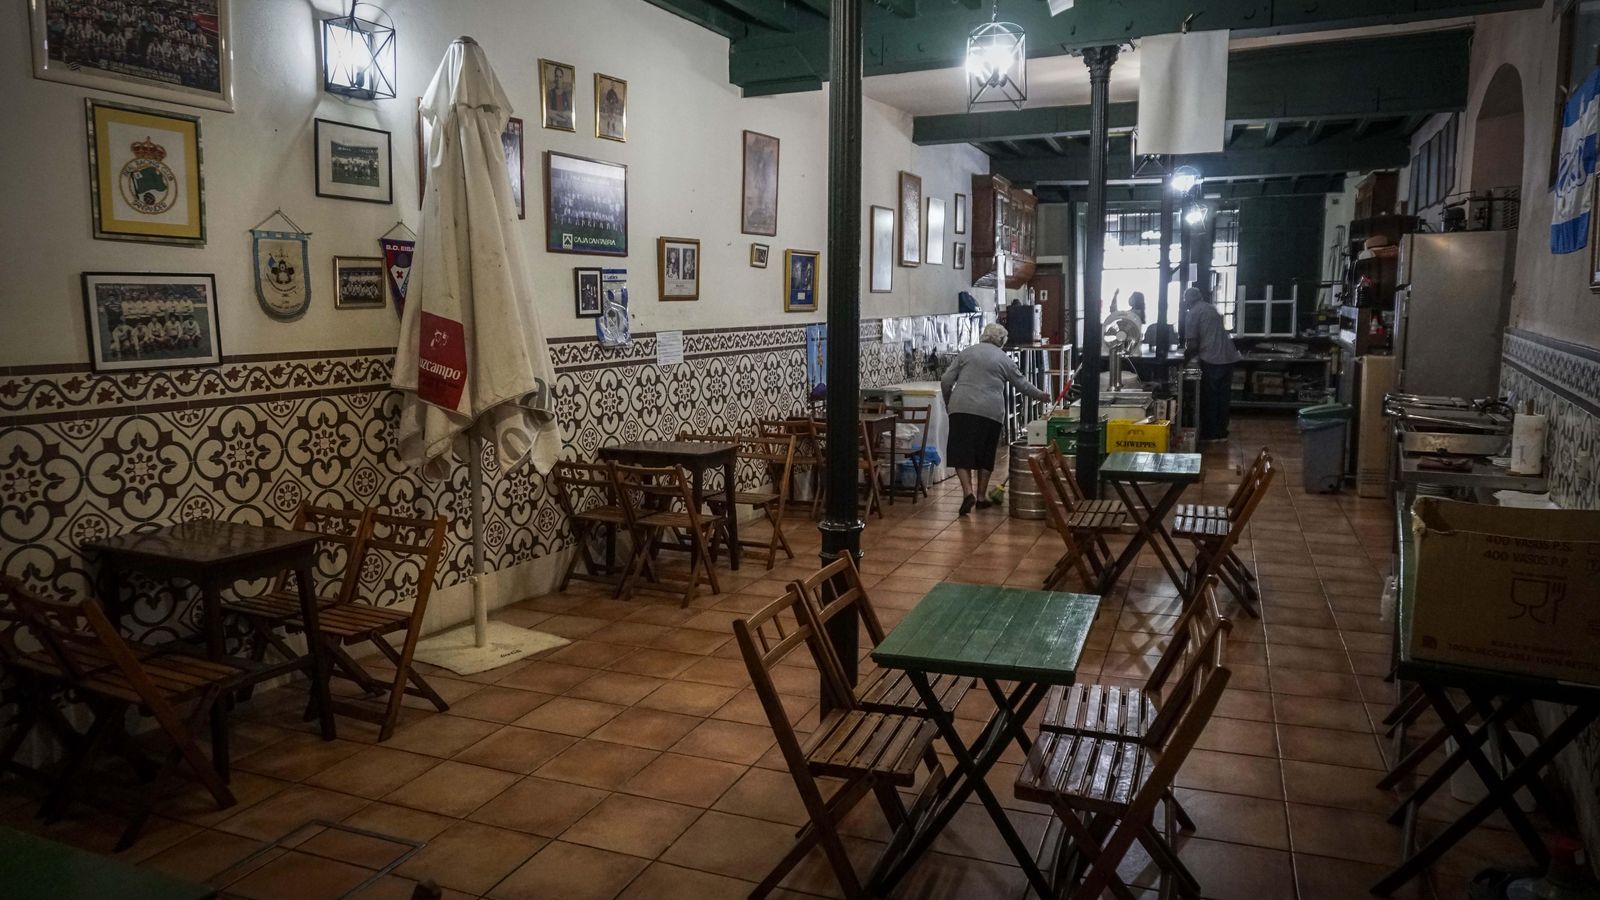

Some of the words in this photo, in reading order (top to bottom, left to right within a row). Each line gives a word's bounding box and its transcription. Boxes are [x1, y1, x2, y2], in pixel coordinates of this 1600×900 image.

[573, 236, 589, 244] CAJA
[589, 238, 616, 246] CANTABRIA
[1115, 440, 1157, 448] SCHWEPPES
[1483, 550, 1509, 561] 400
